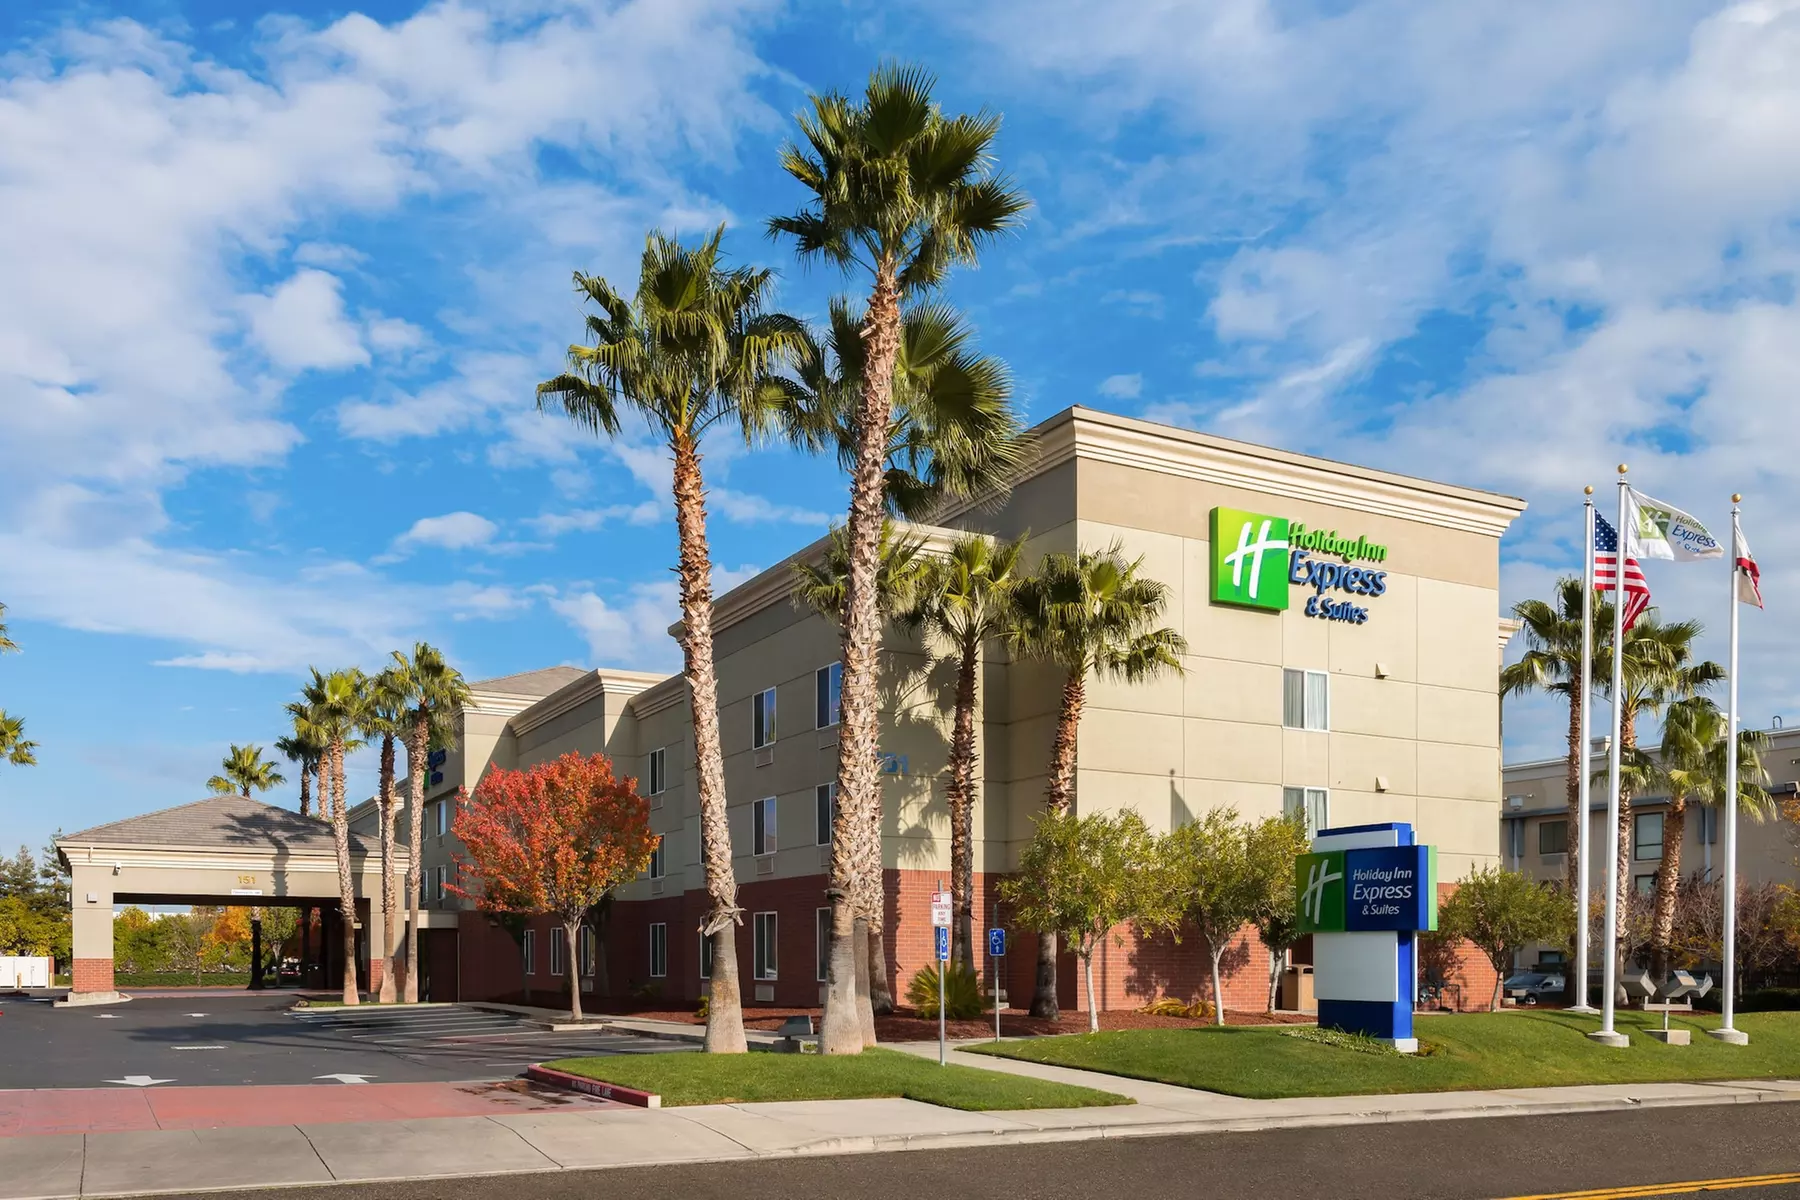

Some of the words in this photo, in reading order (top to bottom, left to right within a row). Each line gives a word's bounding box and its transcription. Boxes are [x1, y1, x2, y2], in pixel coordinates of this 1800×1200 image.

[1289, 522, 1359, 562] Holiday
[1358, 535, 1388, 562] Inn
[1672, 524, 1716, 548] Express
[1288, 550, 1388, 597] Express
[1304, 596, 1319, 618] &
[1320, 597, 1369, 625] Suites
[237, 874, 257, 885] 151
[1352, 867, 1393, 883] Holiday
[1393, 866, 1413, 879] Inn
[1352, 883, 1413, 904] Express
[1361, 904, 1369, 915] &
[1370, 904, 1400, 915] Suites
